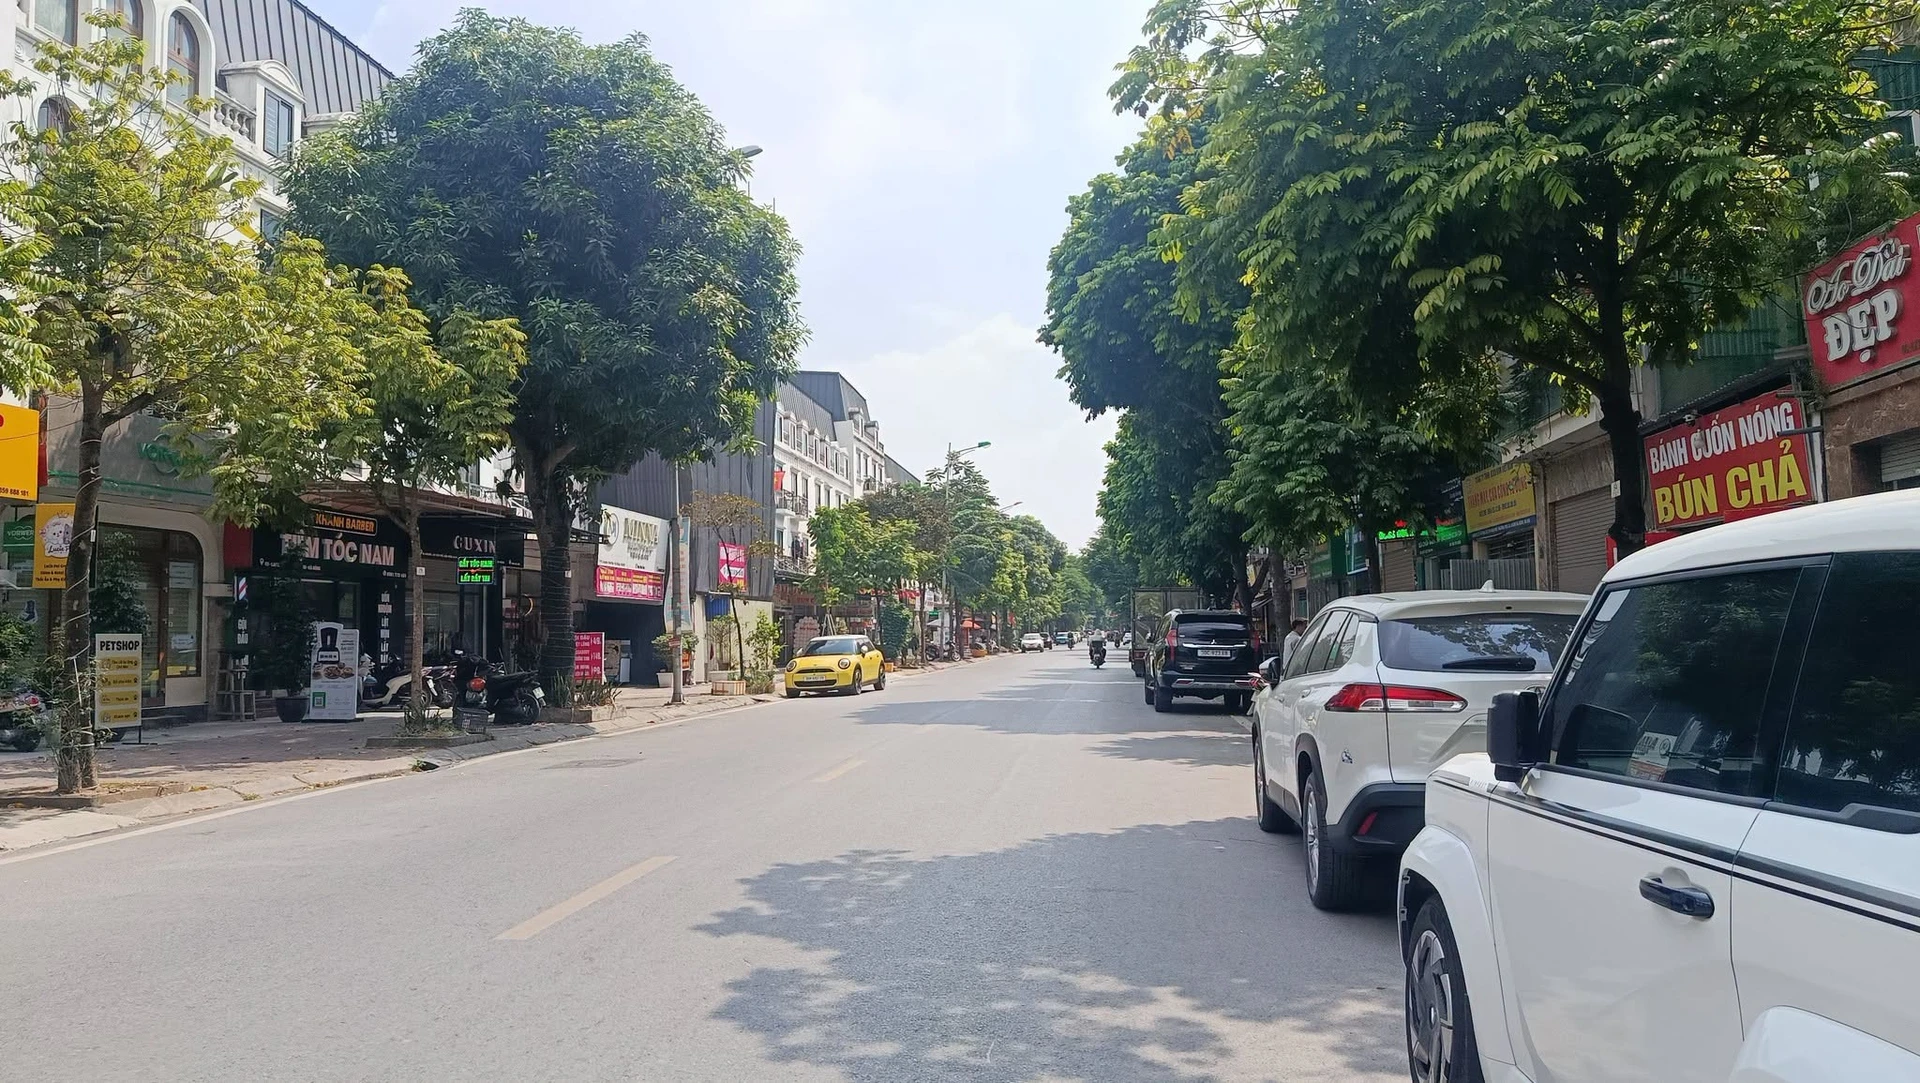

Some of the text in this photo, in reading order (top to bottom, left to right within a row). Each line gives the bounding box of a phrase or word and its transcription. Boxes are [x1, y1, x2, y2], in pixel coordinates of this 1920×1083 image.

[1822, 289, 1900, 363] ĐẸP
[1649, 401, 1796, 475] BÁNH CUỐN NÓNG
[1655, 439, 1808, 524] BÚN CHẢ
[322, 532, 358, 563] TÓC
[359, 543, 395, 566] NAM
[345, 518, 376, 533] BARBER
[100, 640, 140, 651] PETSHOP
